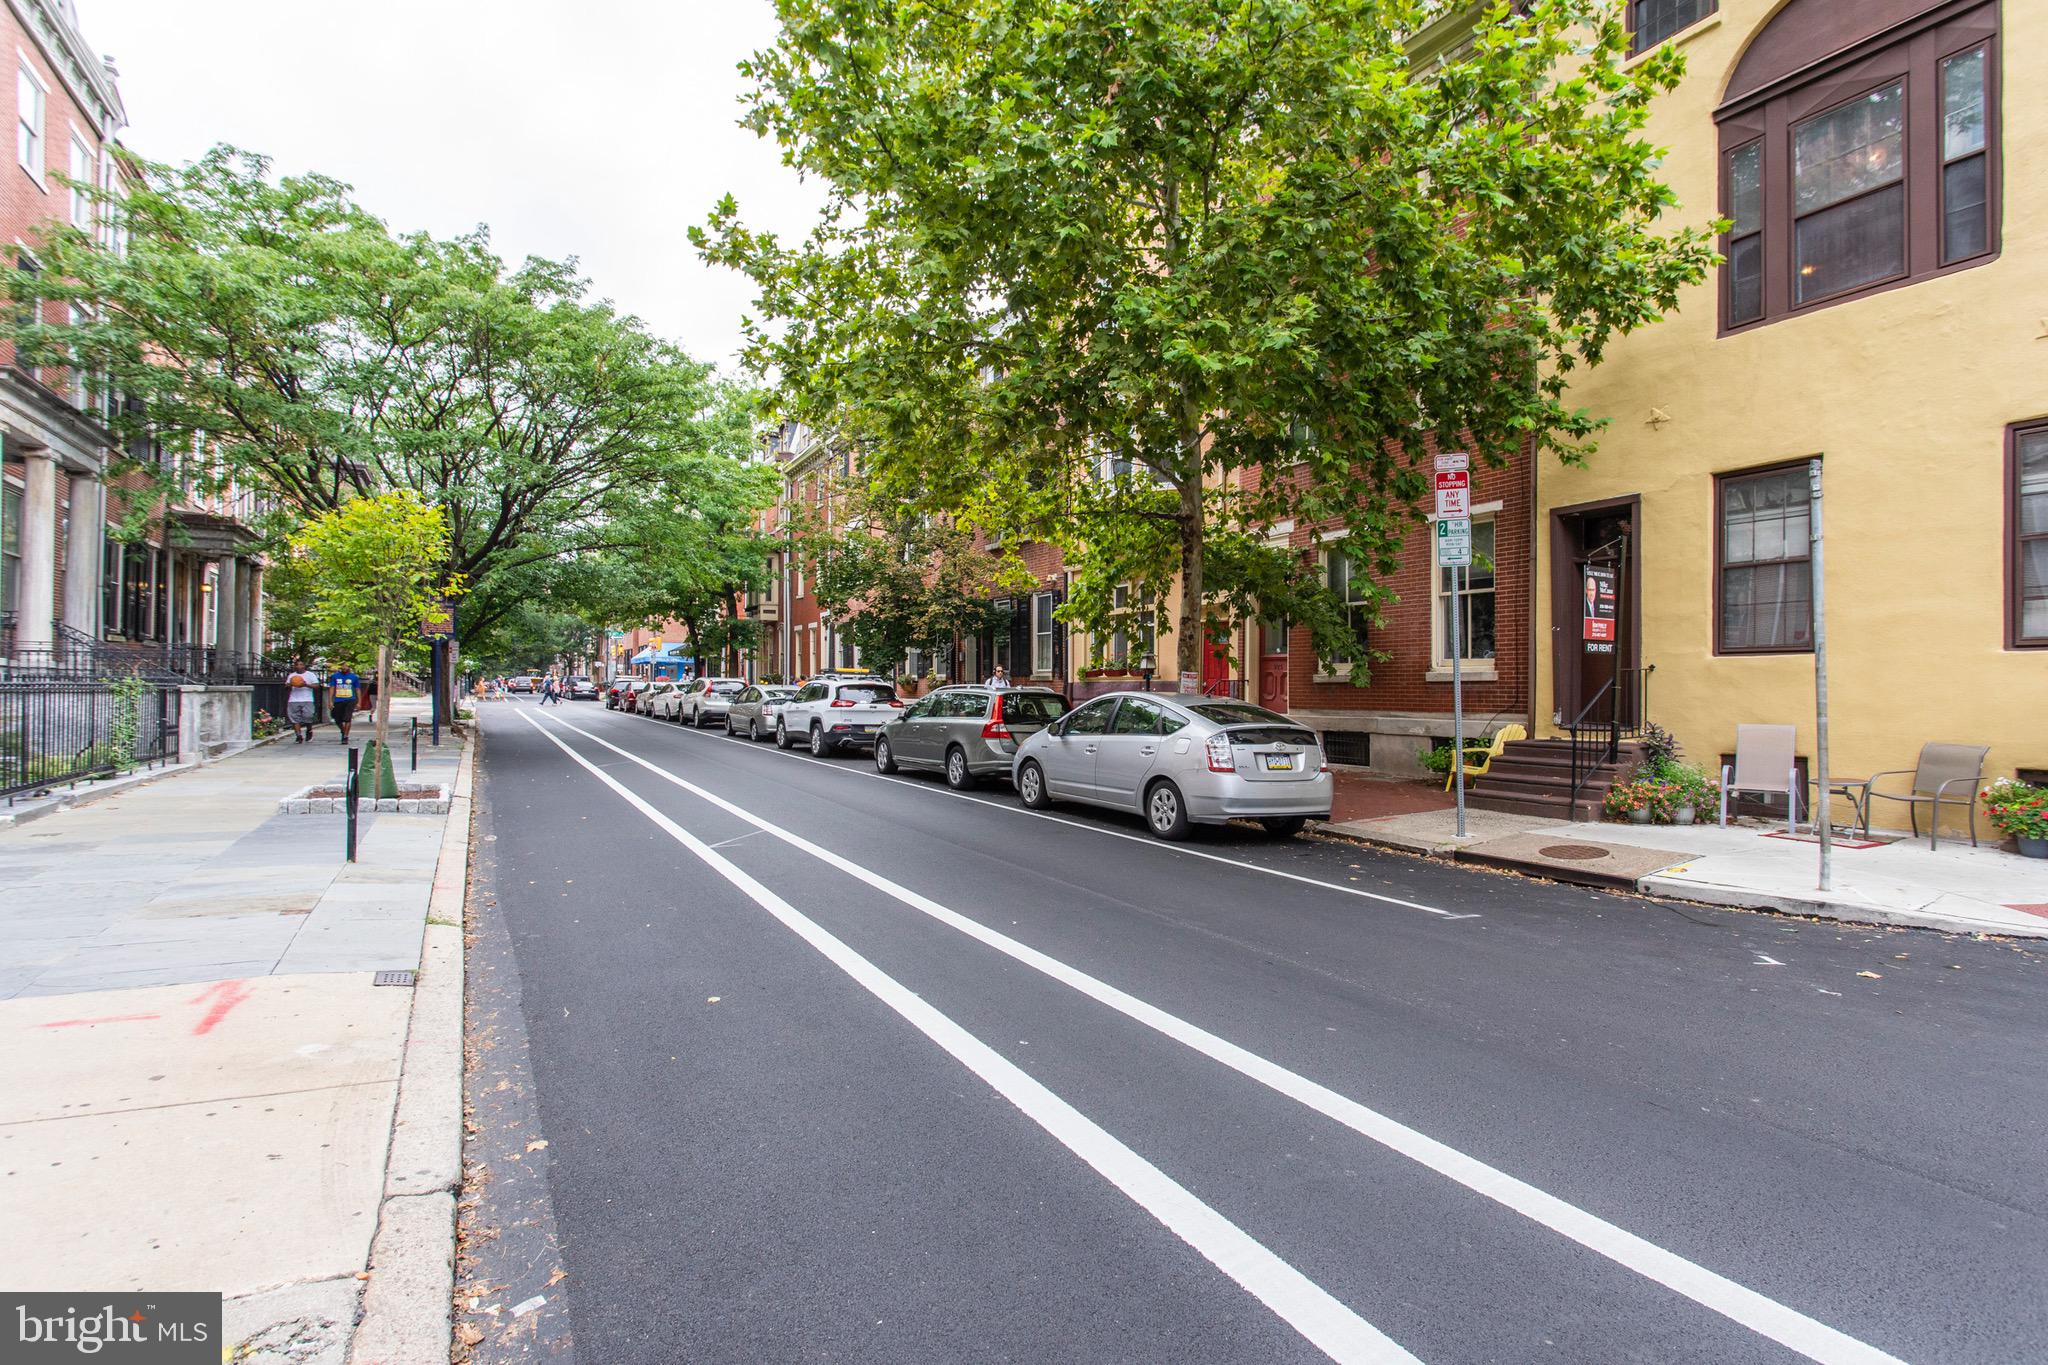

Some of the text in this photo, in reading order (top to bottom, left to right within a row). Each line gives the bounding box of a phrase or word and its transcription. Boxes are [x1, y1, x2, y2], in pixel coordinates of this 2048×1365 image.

[1445, 490, 1460, 499] ANY
[1444, 499, 1461, 507] TIME
[1440, 524, 1446, 535] 2
[1448, 527, 1469, 536] PARKING
[1587, 643, 1613, 653] FOR RENT
